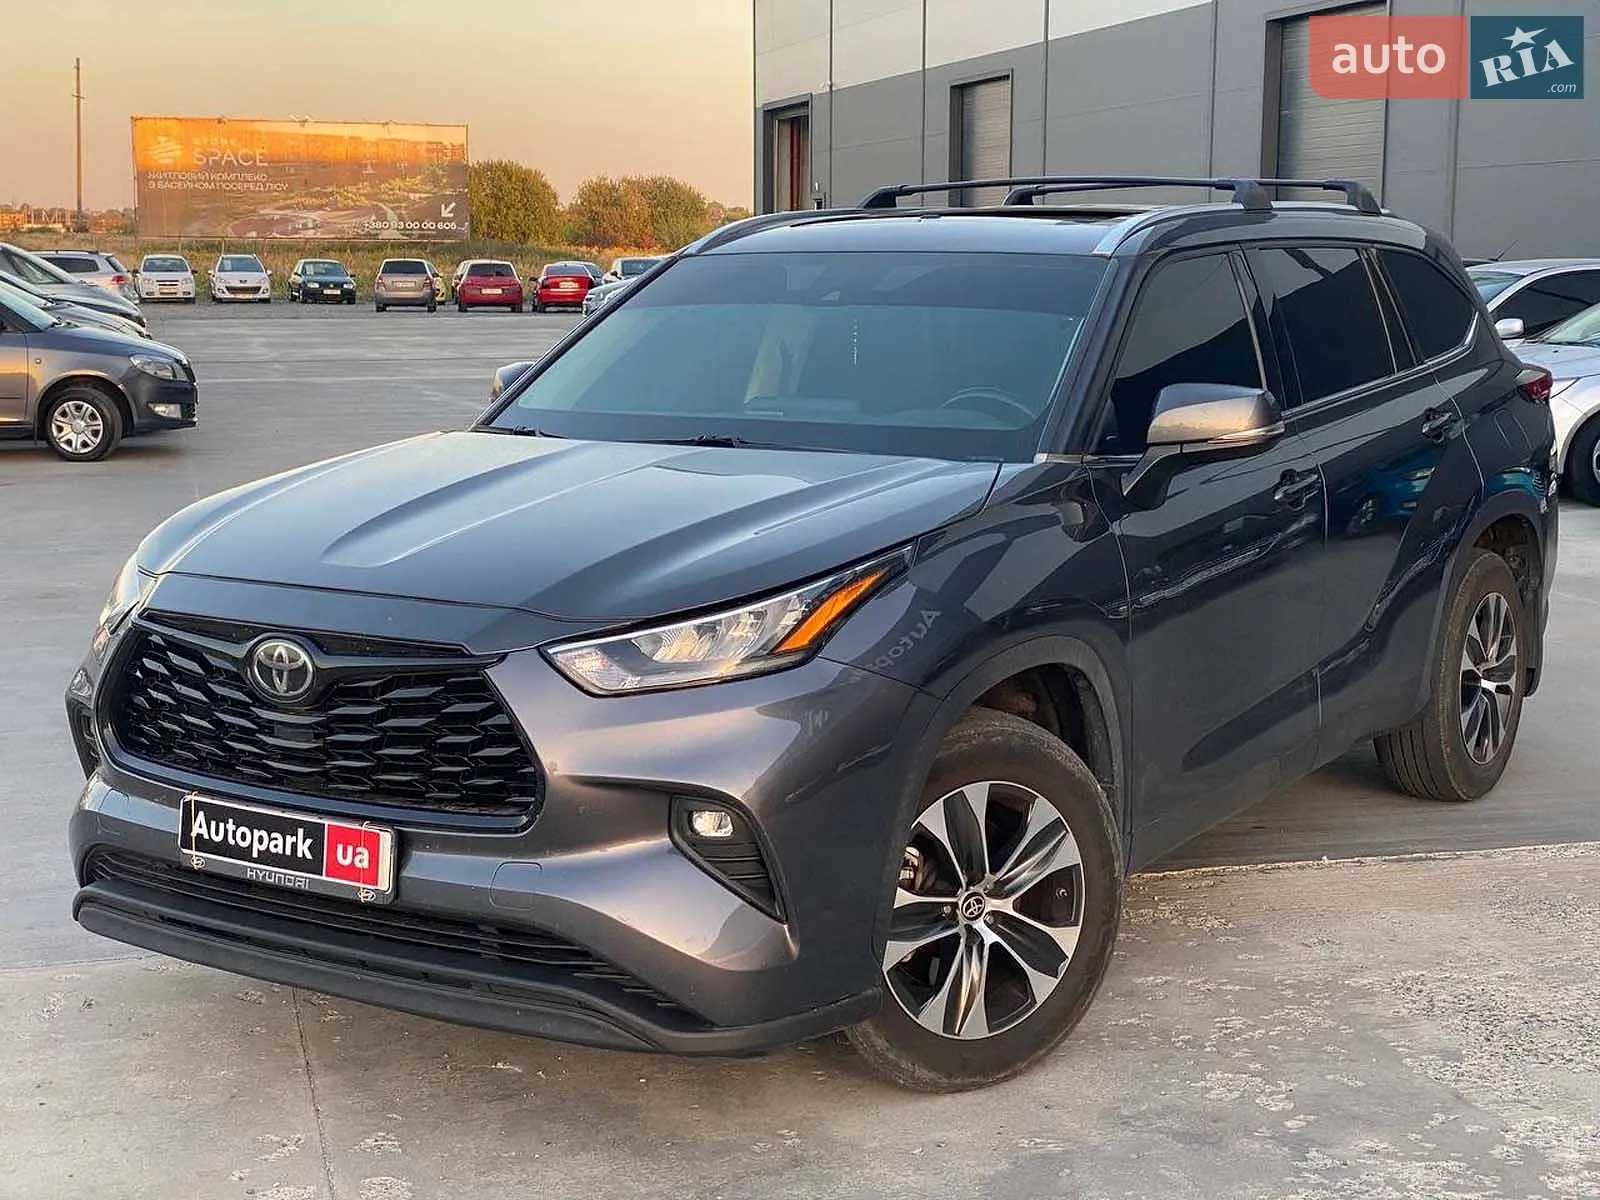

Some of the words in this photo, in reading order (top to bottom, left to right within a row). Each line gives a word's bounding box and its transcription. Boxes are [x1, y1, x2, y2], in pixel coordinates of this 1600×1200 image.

[193, 148, 269, 166] SPACE
[210, 172, 268, 182] КОМПЛЕКС
[192, 811, 313, 860] Autopark
[336, 842, 370, 869] ua
[246, 867, 310, 889] HYUNDAI
